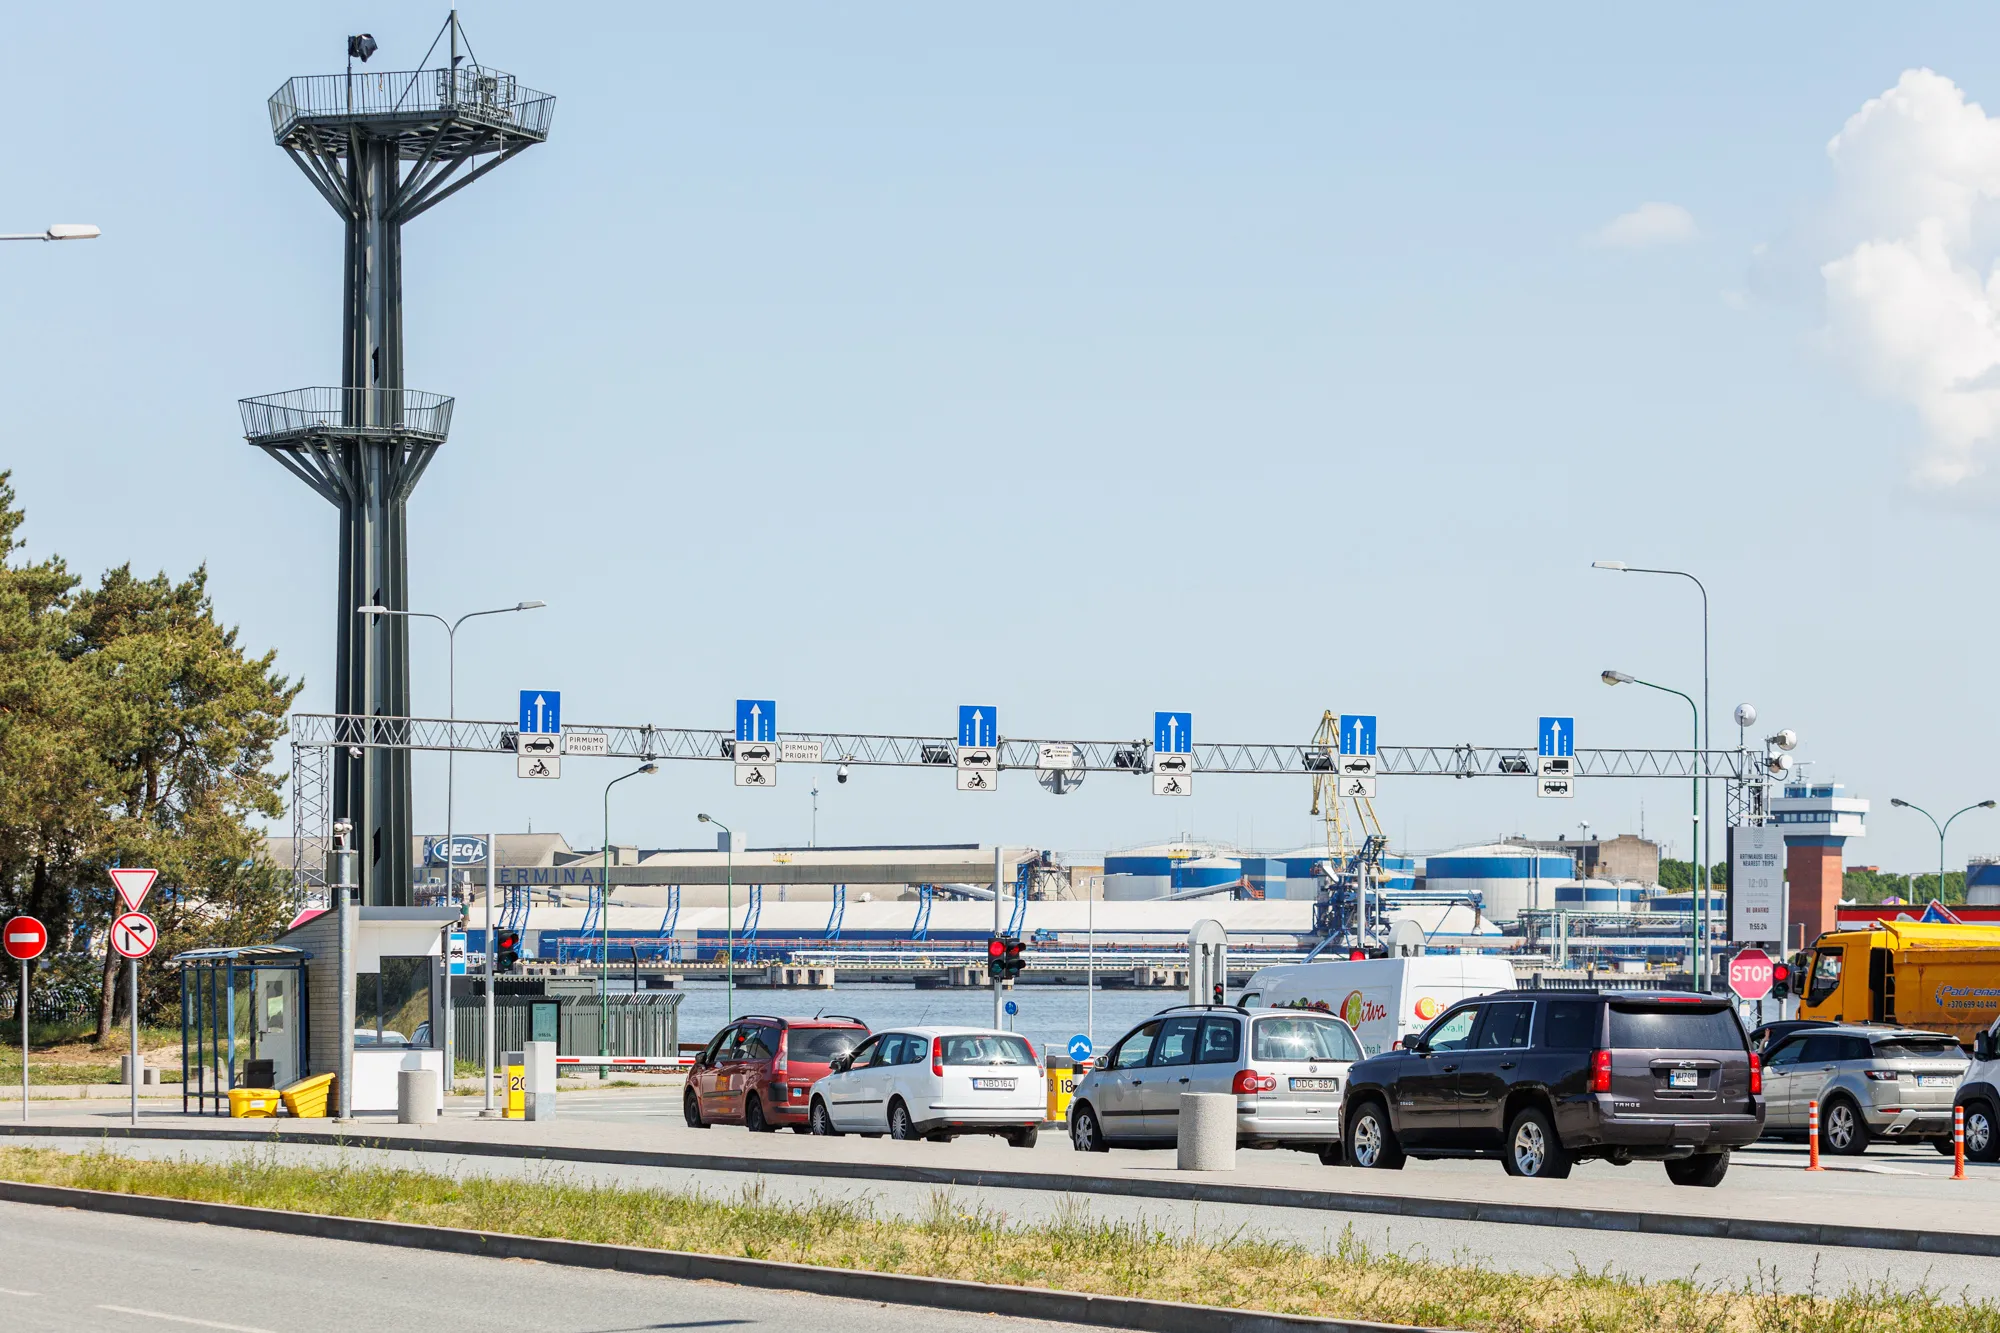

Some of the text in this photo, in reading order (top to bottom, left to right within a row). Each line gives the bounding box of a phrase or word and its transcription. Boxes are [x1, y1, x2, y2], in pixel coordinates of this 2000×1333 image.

[484, 868, 611, 884] ERMINAL
[1748, 878, 1768, 888] 12:00
[1732, 965, 1773, 982] STOP
[1047, 1079, 1054, 1092] 18
[1060, 1079, 1073, 1093] 18
[1295, 1079, 1333, 1088] DDG 687
